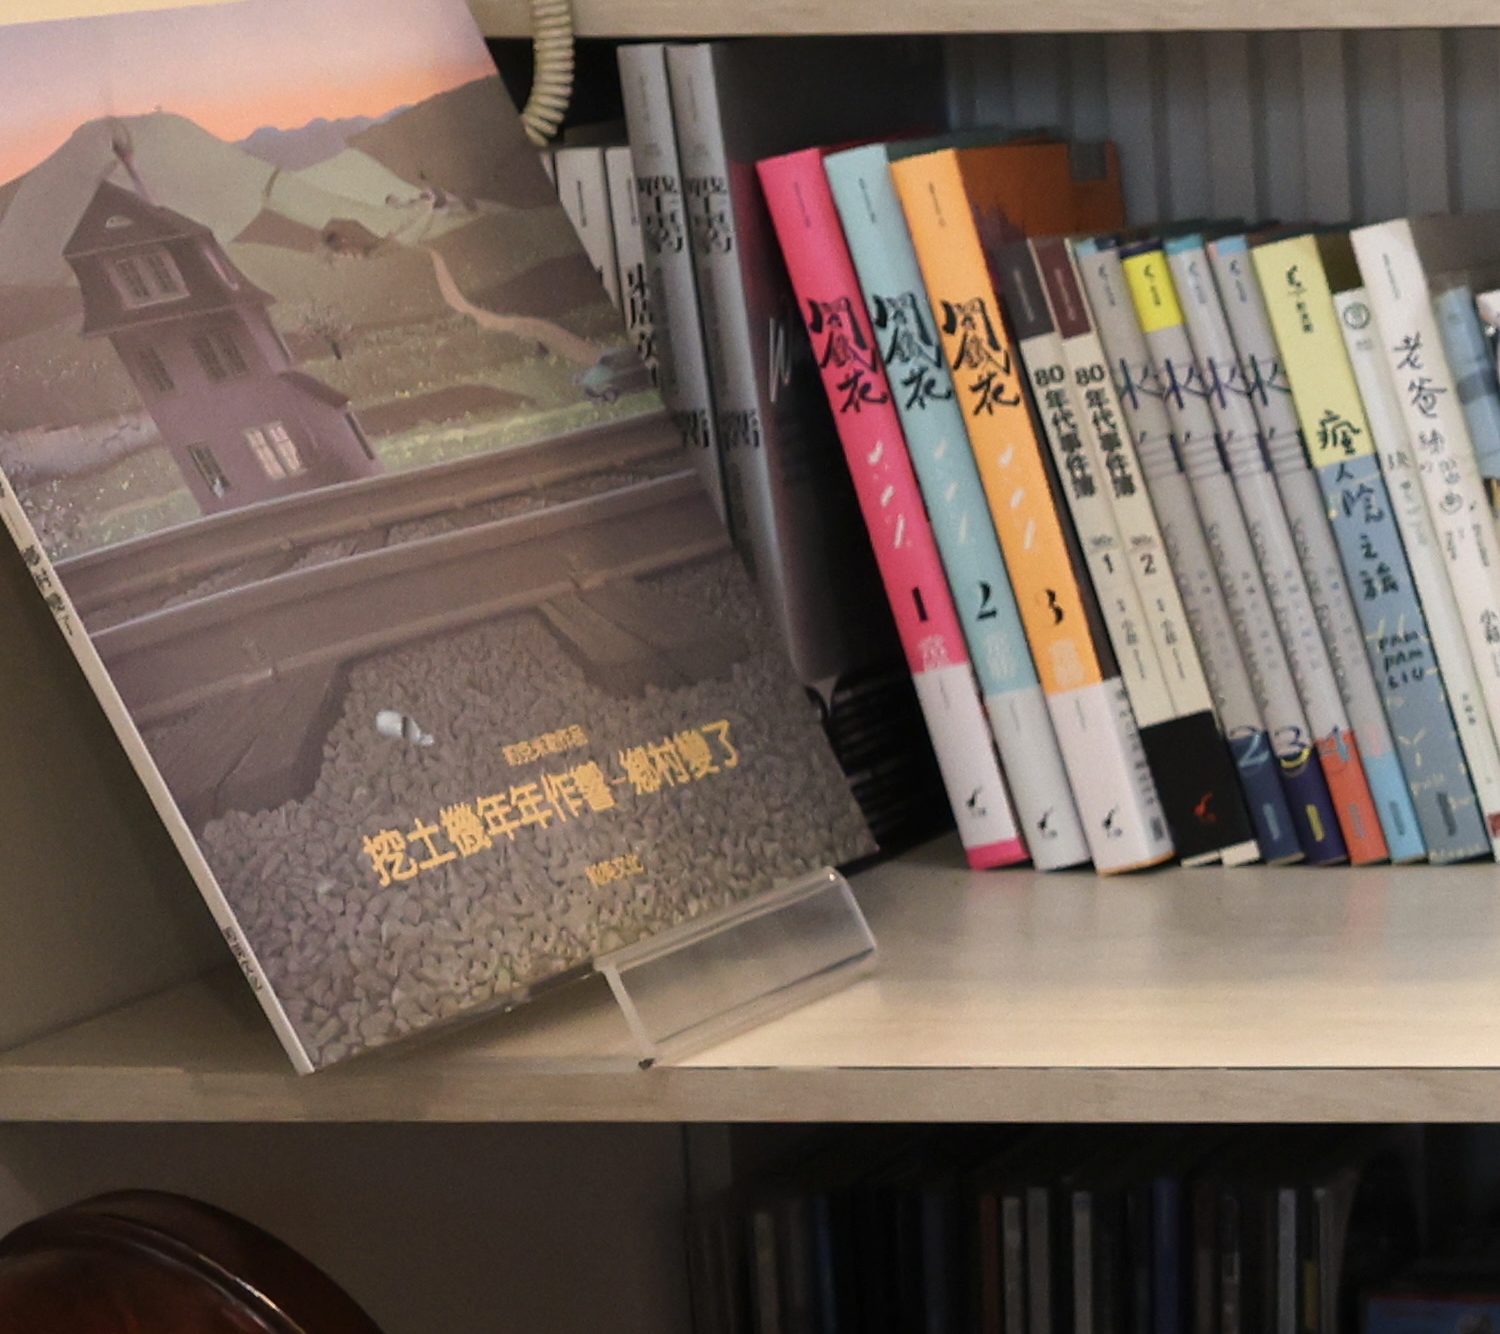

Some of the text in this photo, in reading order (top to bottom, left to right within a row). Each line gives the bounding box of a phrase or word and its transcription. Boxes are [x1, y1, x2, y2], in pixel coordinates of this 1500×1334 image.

[1318, 409, 1402, 600] 瘋人院之旅
